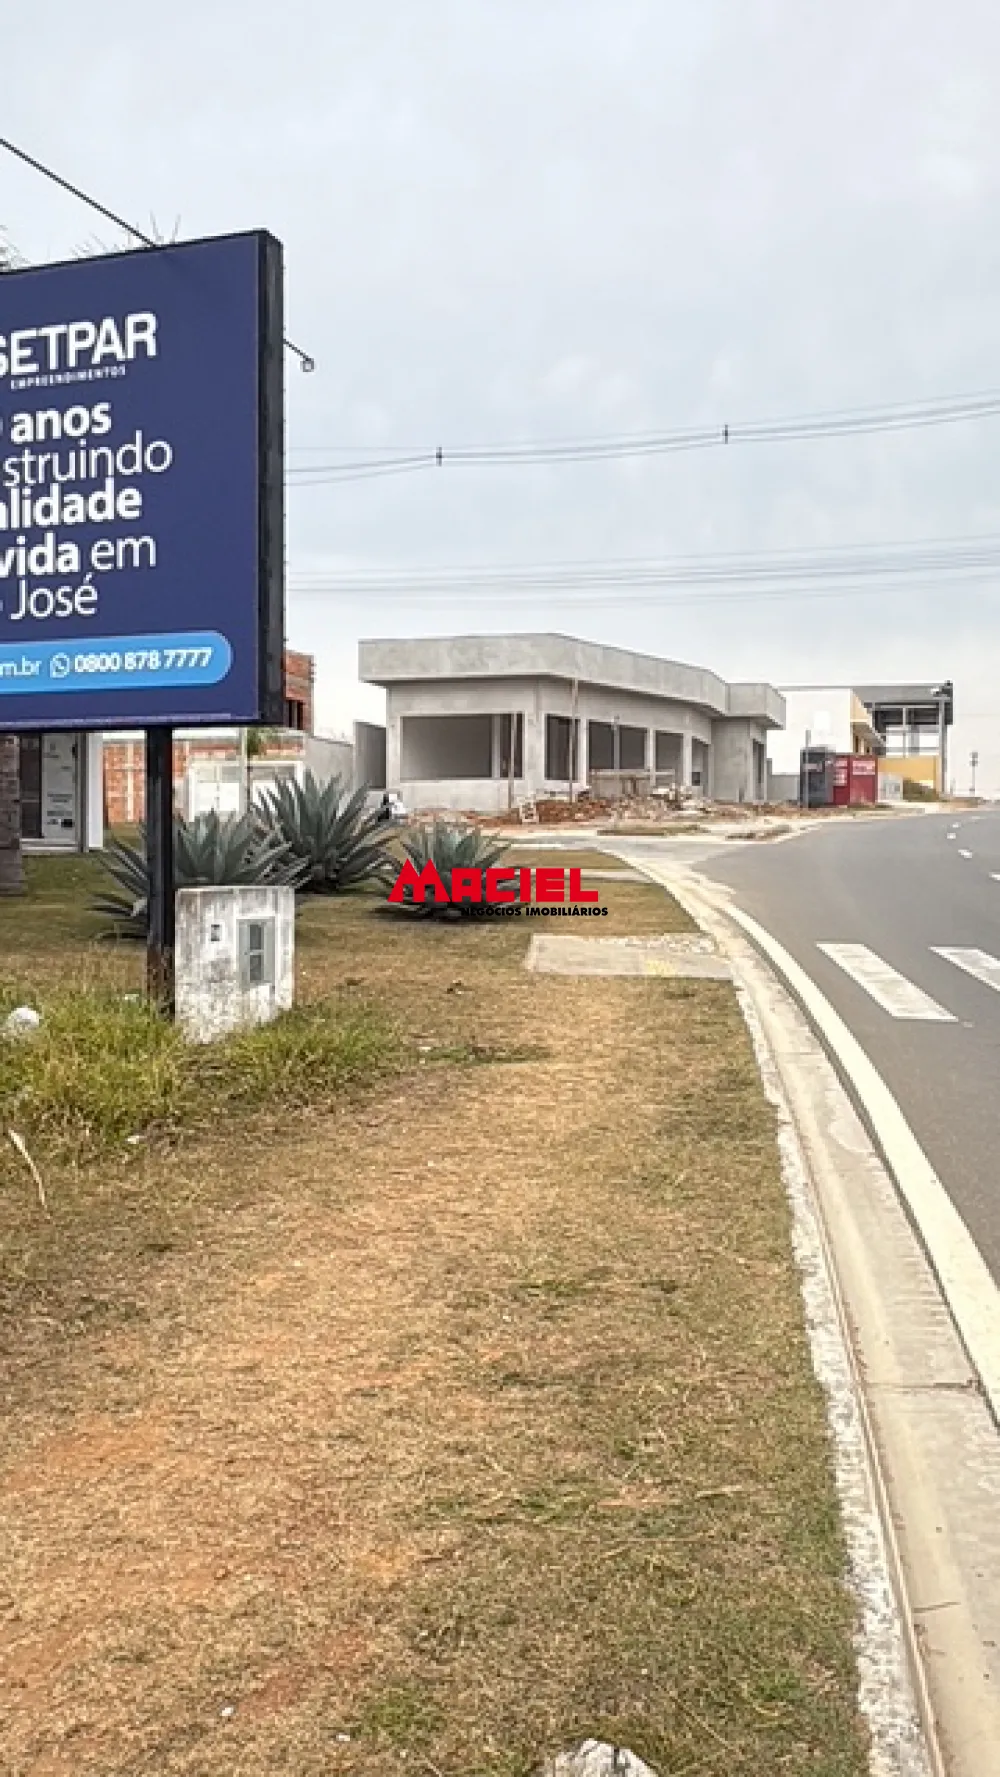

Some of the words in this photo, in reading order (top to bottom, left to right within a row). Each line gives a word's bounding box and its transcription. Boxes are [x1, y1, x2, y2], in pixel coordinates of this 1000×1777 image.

[0, 311, 158, 378] ETPAR
[10, 402, 112, 444] anos
[3, 430, 173, 488] struindo
[91, 535, 157, 571] em
[10, 572, 99, 621] José
[74, 652, 120, 674] 0800
[124, 650, 160, 672] 878
[163, 647, 212, 669] 7777
